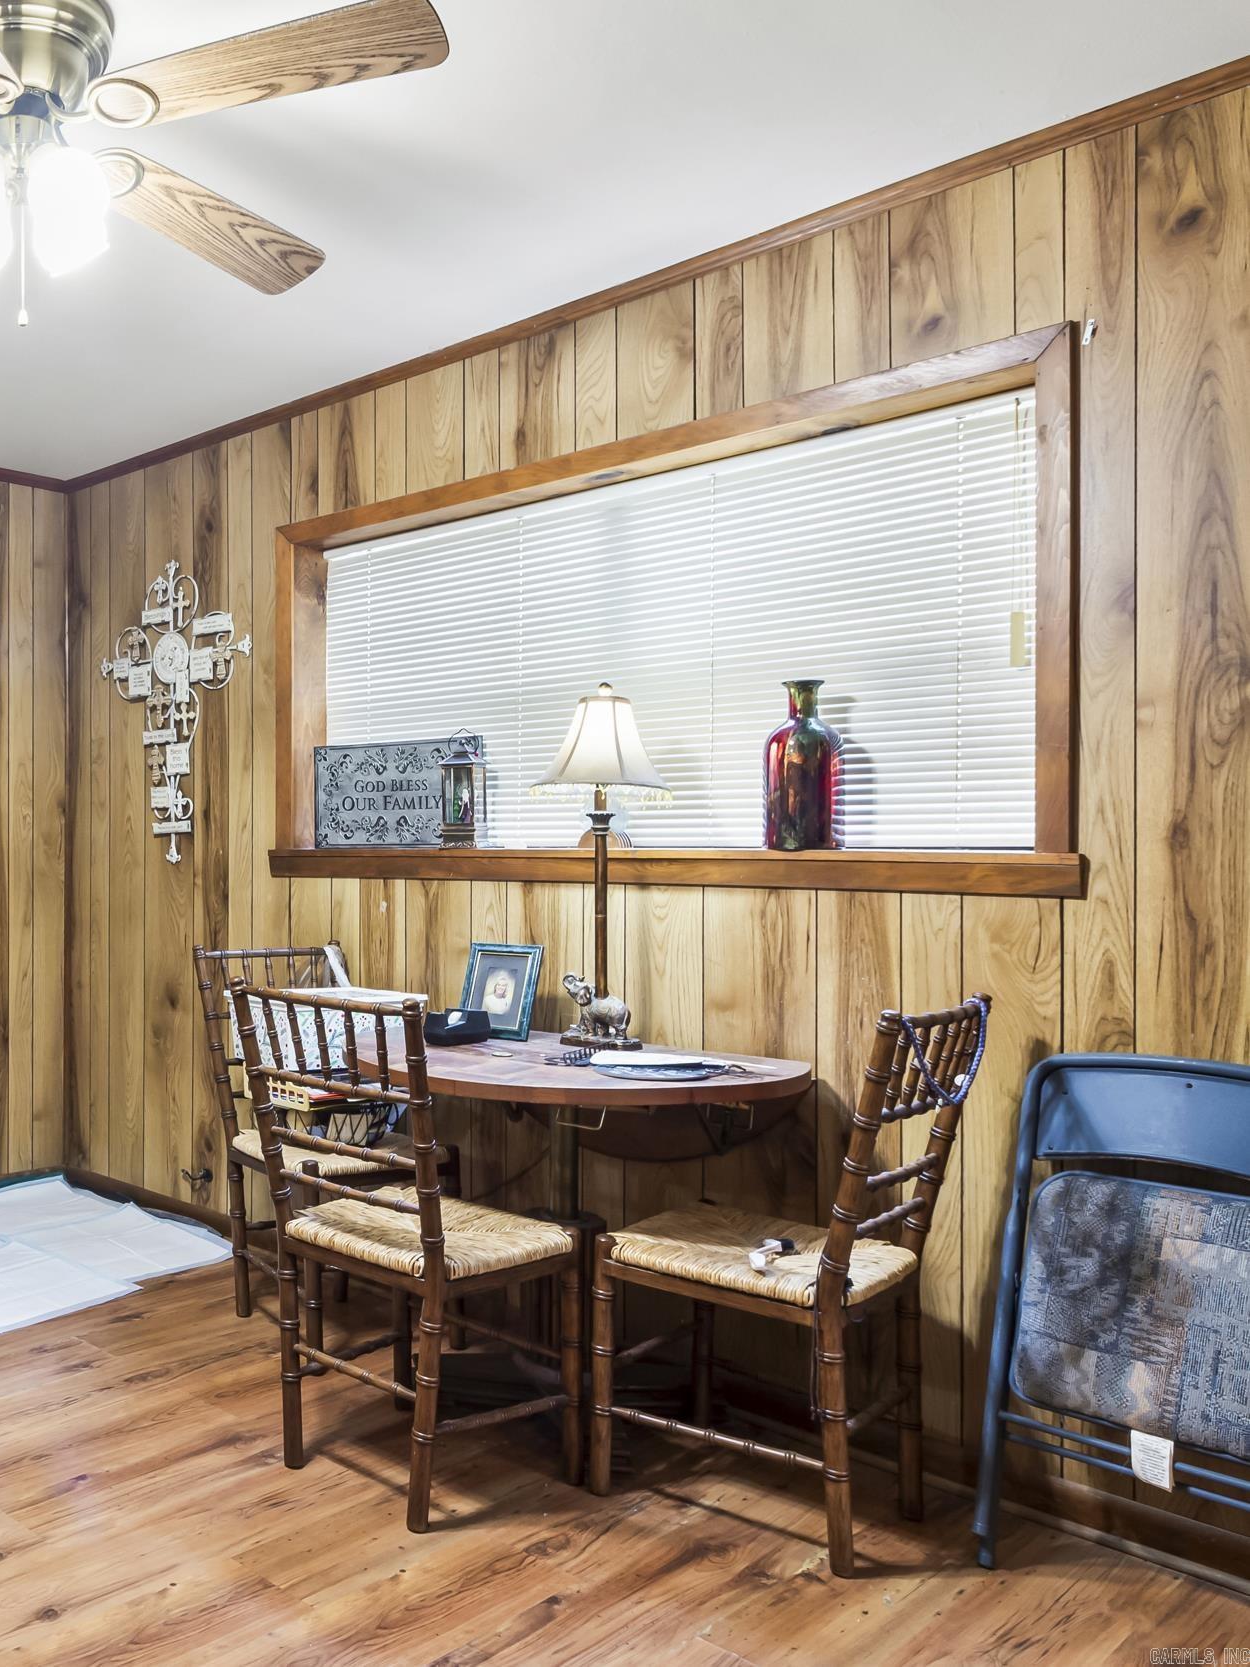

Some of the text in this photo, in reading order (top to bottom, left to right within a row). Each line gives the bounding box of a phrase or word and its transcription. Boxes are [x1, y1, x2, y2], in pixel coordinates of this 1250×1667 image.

[354, 779, 428, 793] GOD BLESS
[342, 795, 443, 812] OUR FAMILY
